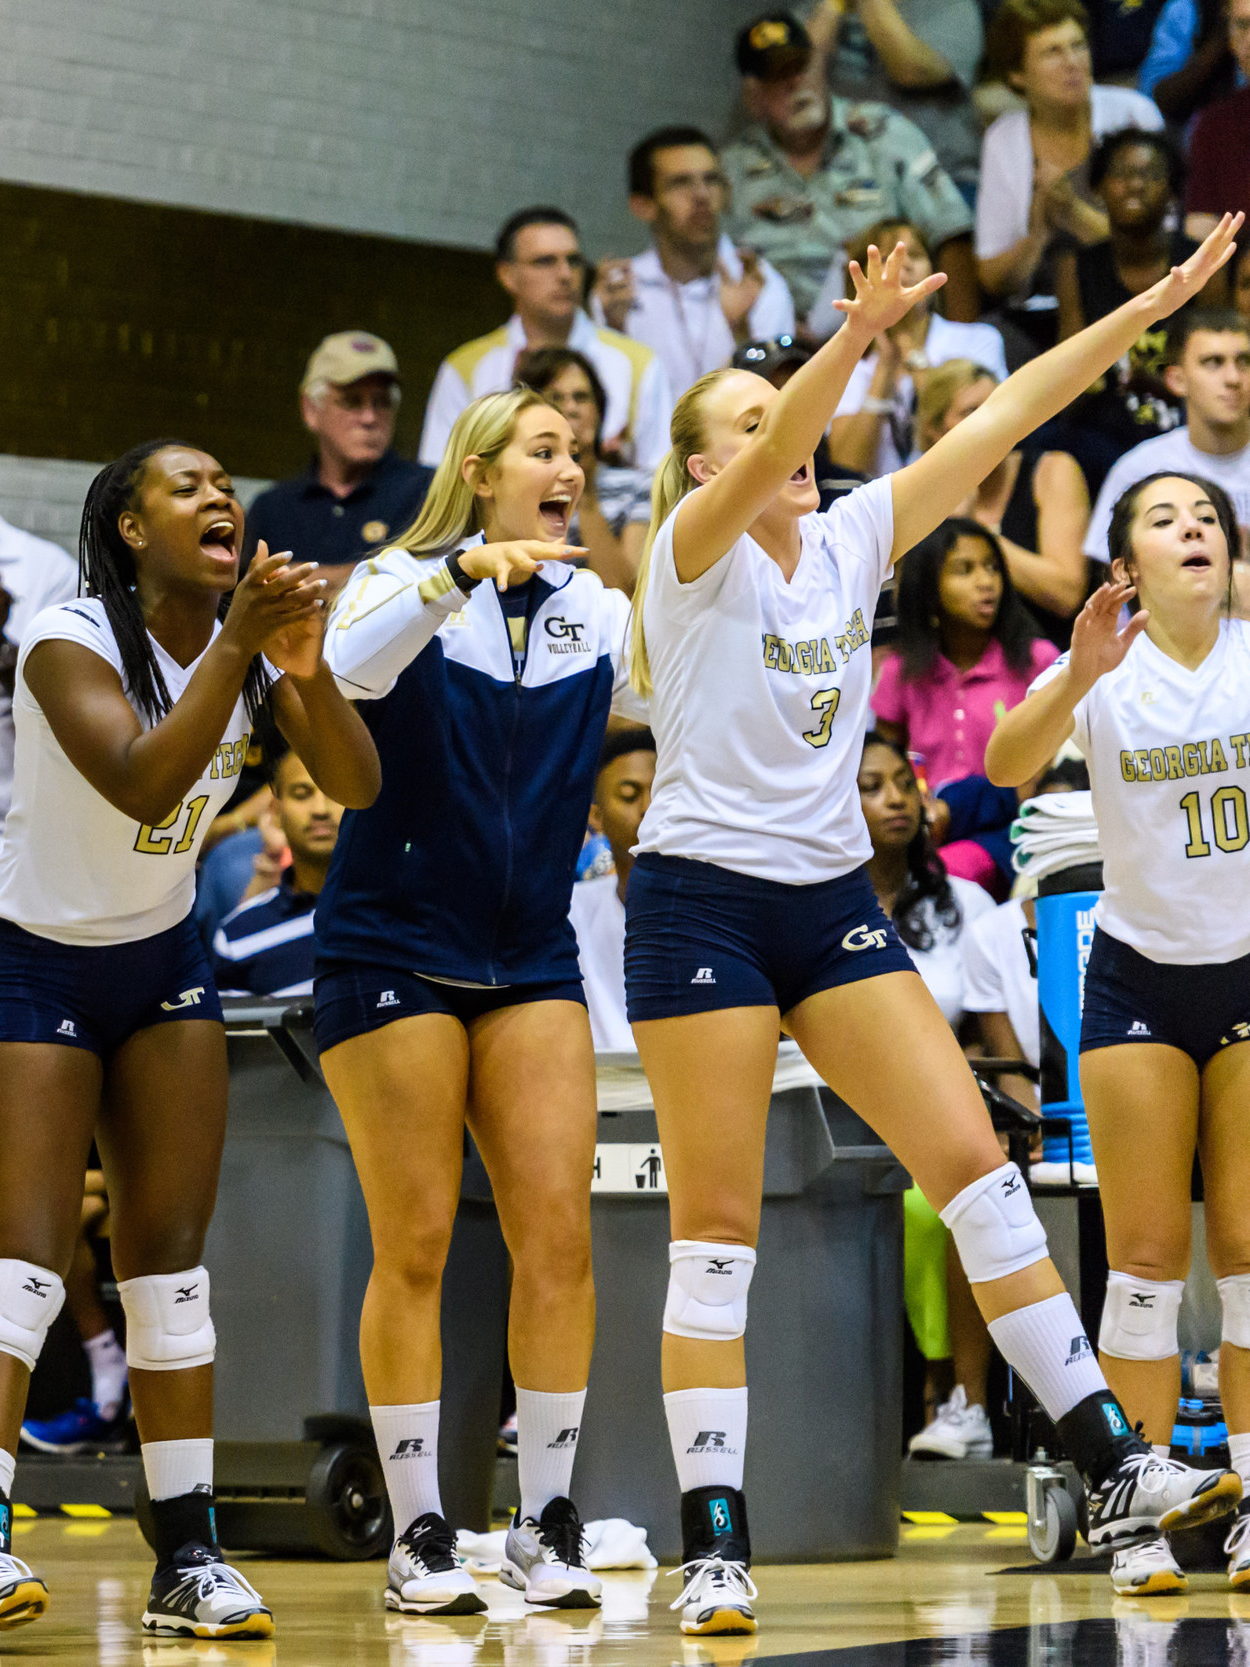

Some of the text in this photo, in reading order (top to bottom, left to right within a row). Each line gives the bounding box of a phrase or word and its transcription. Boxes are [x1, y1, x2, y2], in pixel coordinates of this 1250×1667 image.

[544, 616, 585, 641] GT
[802, 687, 841, 749] 3
[1120, 739, 1229, 782] GEORGIA
[133, 795, 210, 855] 21
[1180, 785, 1250, 859] 10
[841, 924, 887, 951] GT
[686, 1446, 738, 1455] RUSSELL
